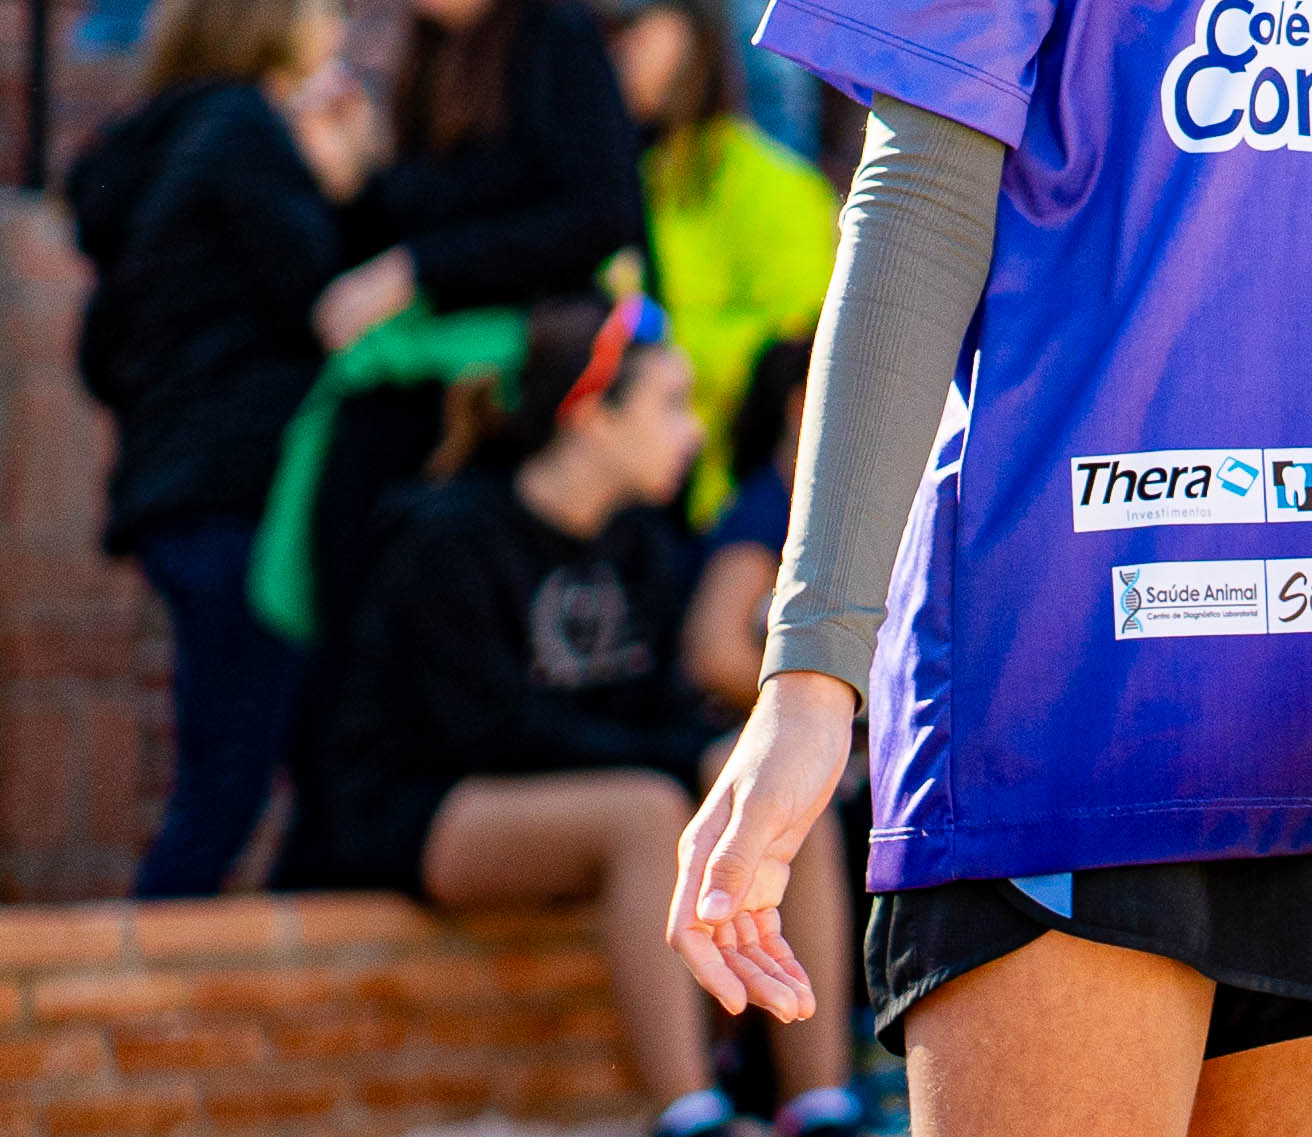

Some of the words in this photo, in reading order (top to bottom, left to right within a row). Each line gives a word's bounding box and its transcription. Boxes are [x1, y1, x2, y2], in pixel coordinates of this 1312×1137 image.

[1077, 461, 1212, 505] Thera
[1126, 504, 1212, 522] Investimentos
[1146, 584, 1200, 603] Saúde
[1204, 583, 1257, 601] Animal
